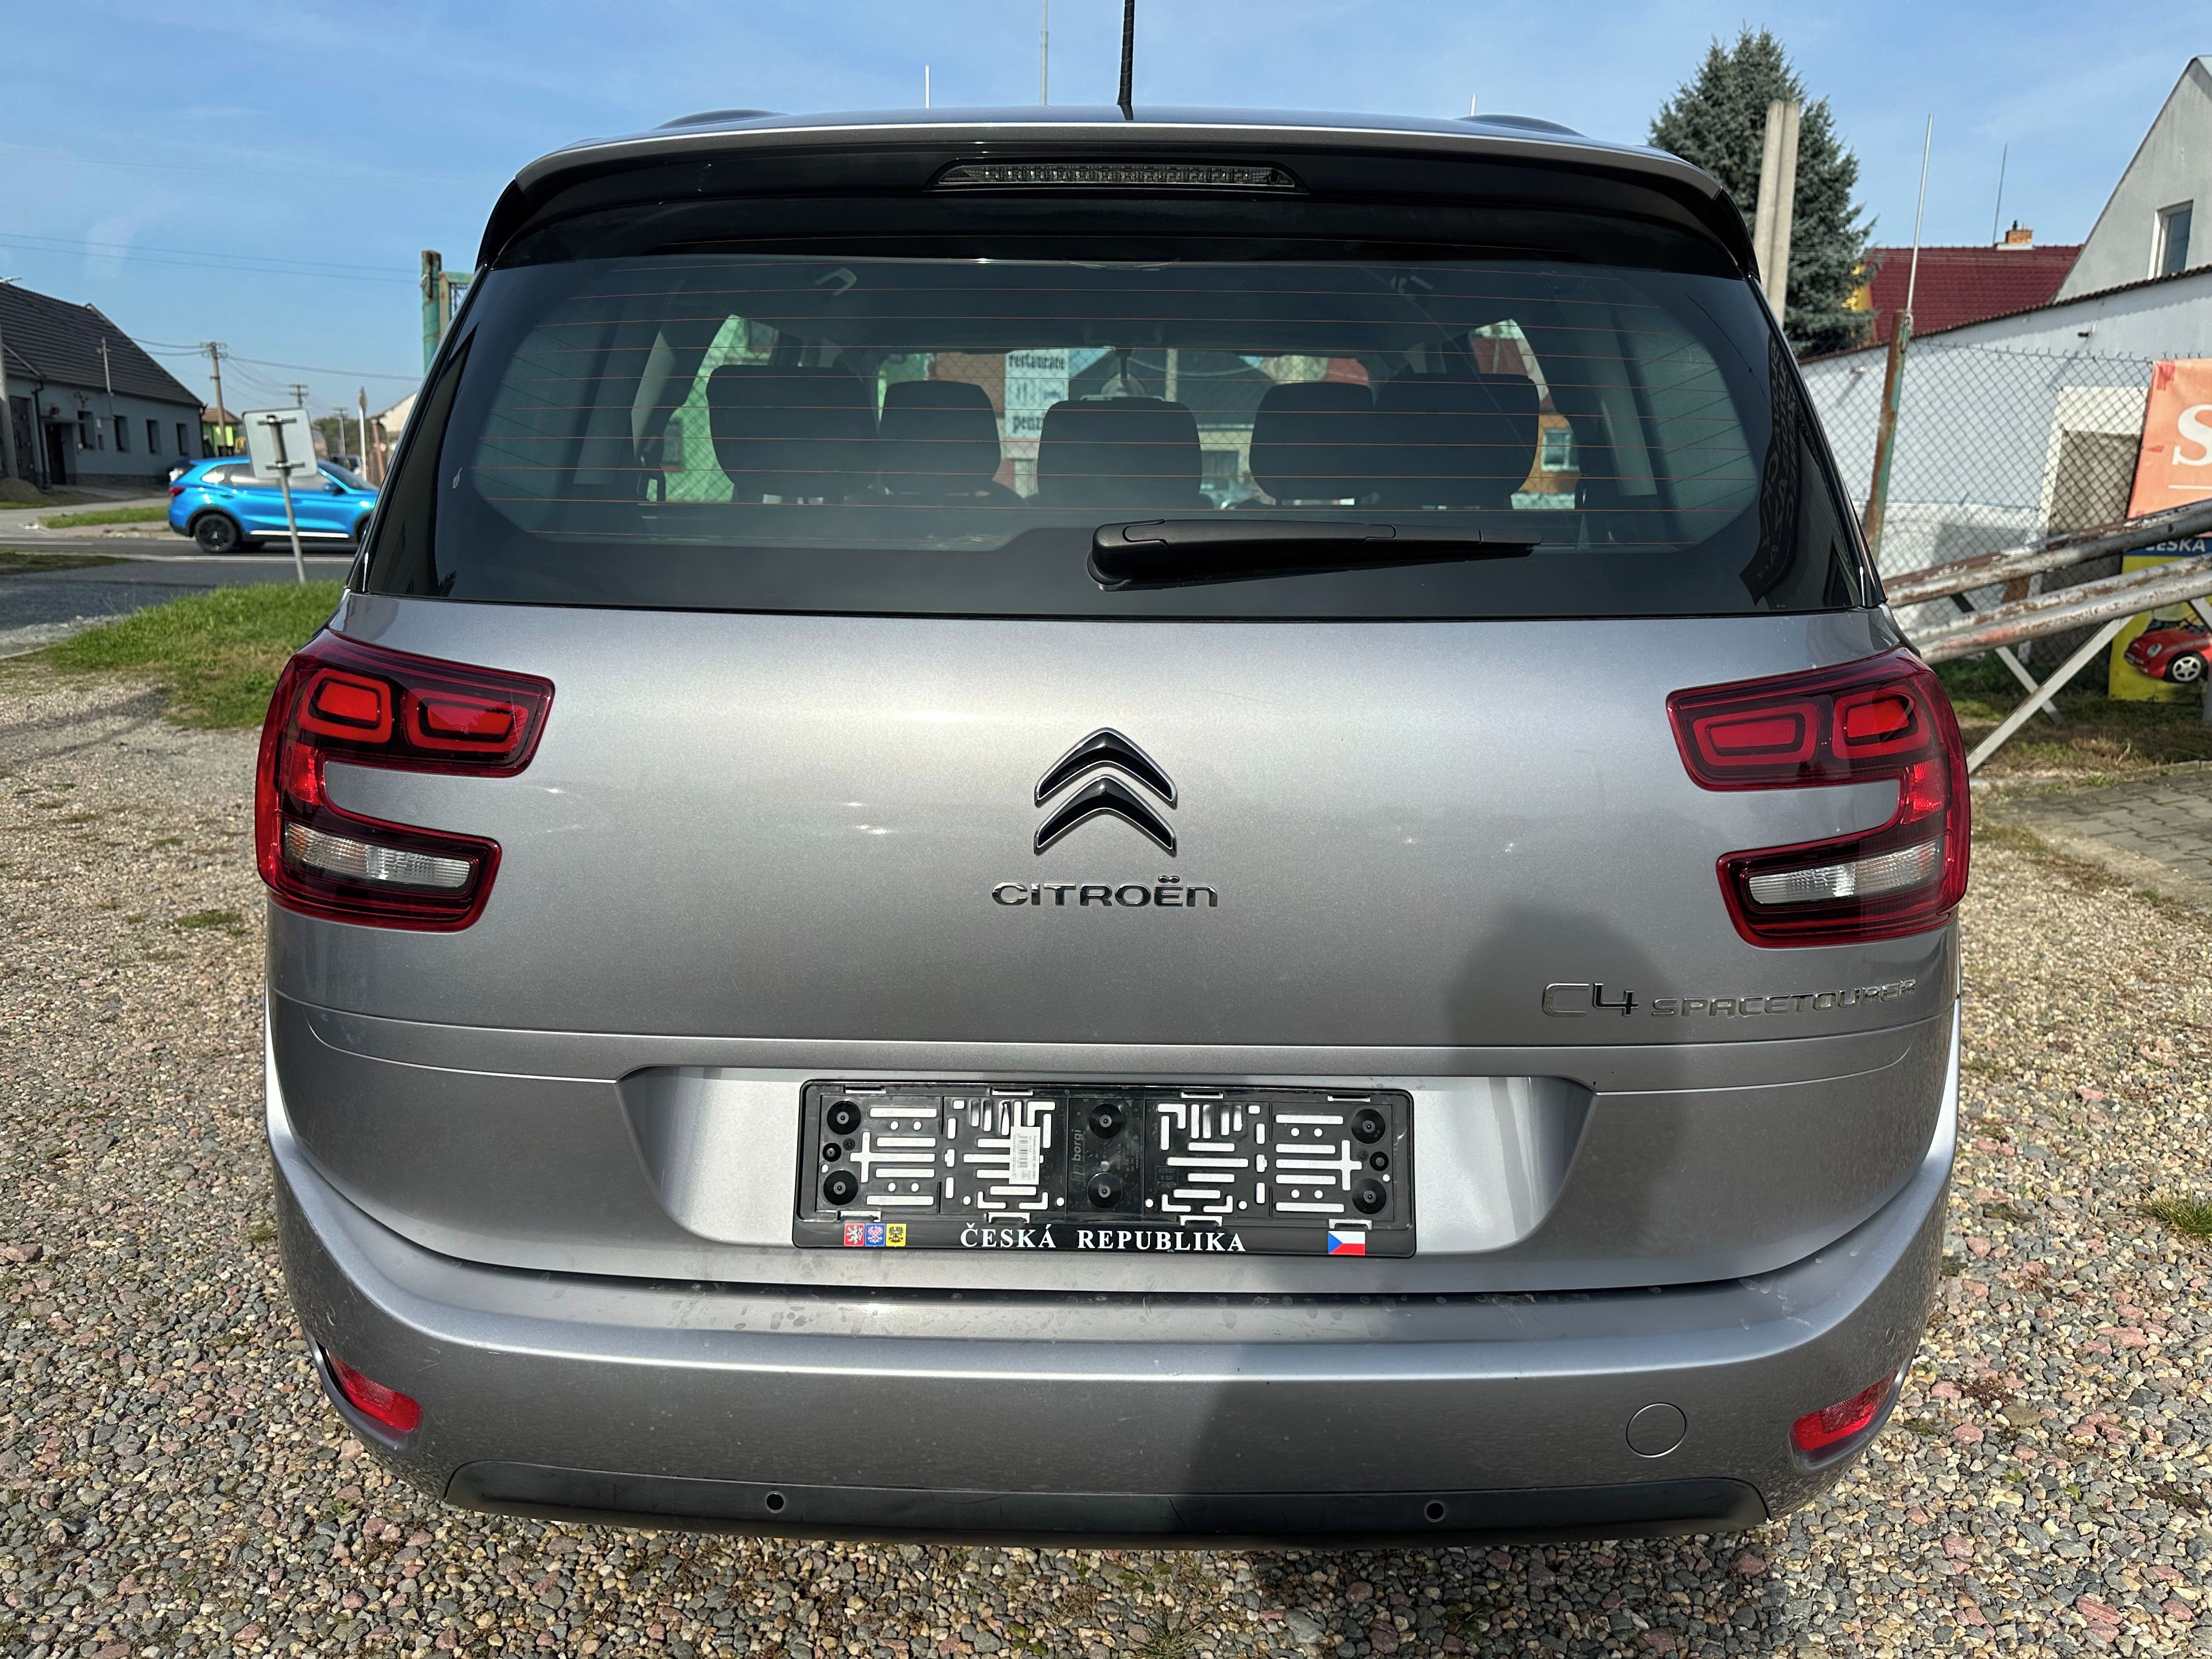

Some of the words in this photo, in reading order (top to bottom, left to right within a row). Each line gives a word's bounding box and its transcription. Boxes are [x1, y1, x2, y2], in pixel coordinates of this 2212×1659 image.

[1013, 416, 1044, 433] penz
[992, 875, 1218, 907] CITROËN
[1542, 983, 1639, 1017] C4
[1651, 978, 1916, 1017] SPACETOURER
[1071, 1128, 1084, 1161] borgi
[960, 1222, 1056, 1248] ČESKÁ
[1076, 1229, 1246, 1252] REPUBLIKA
